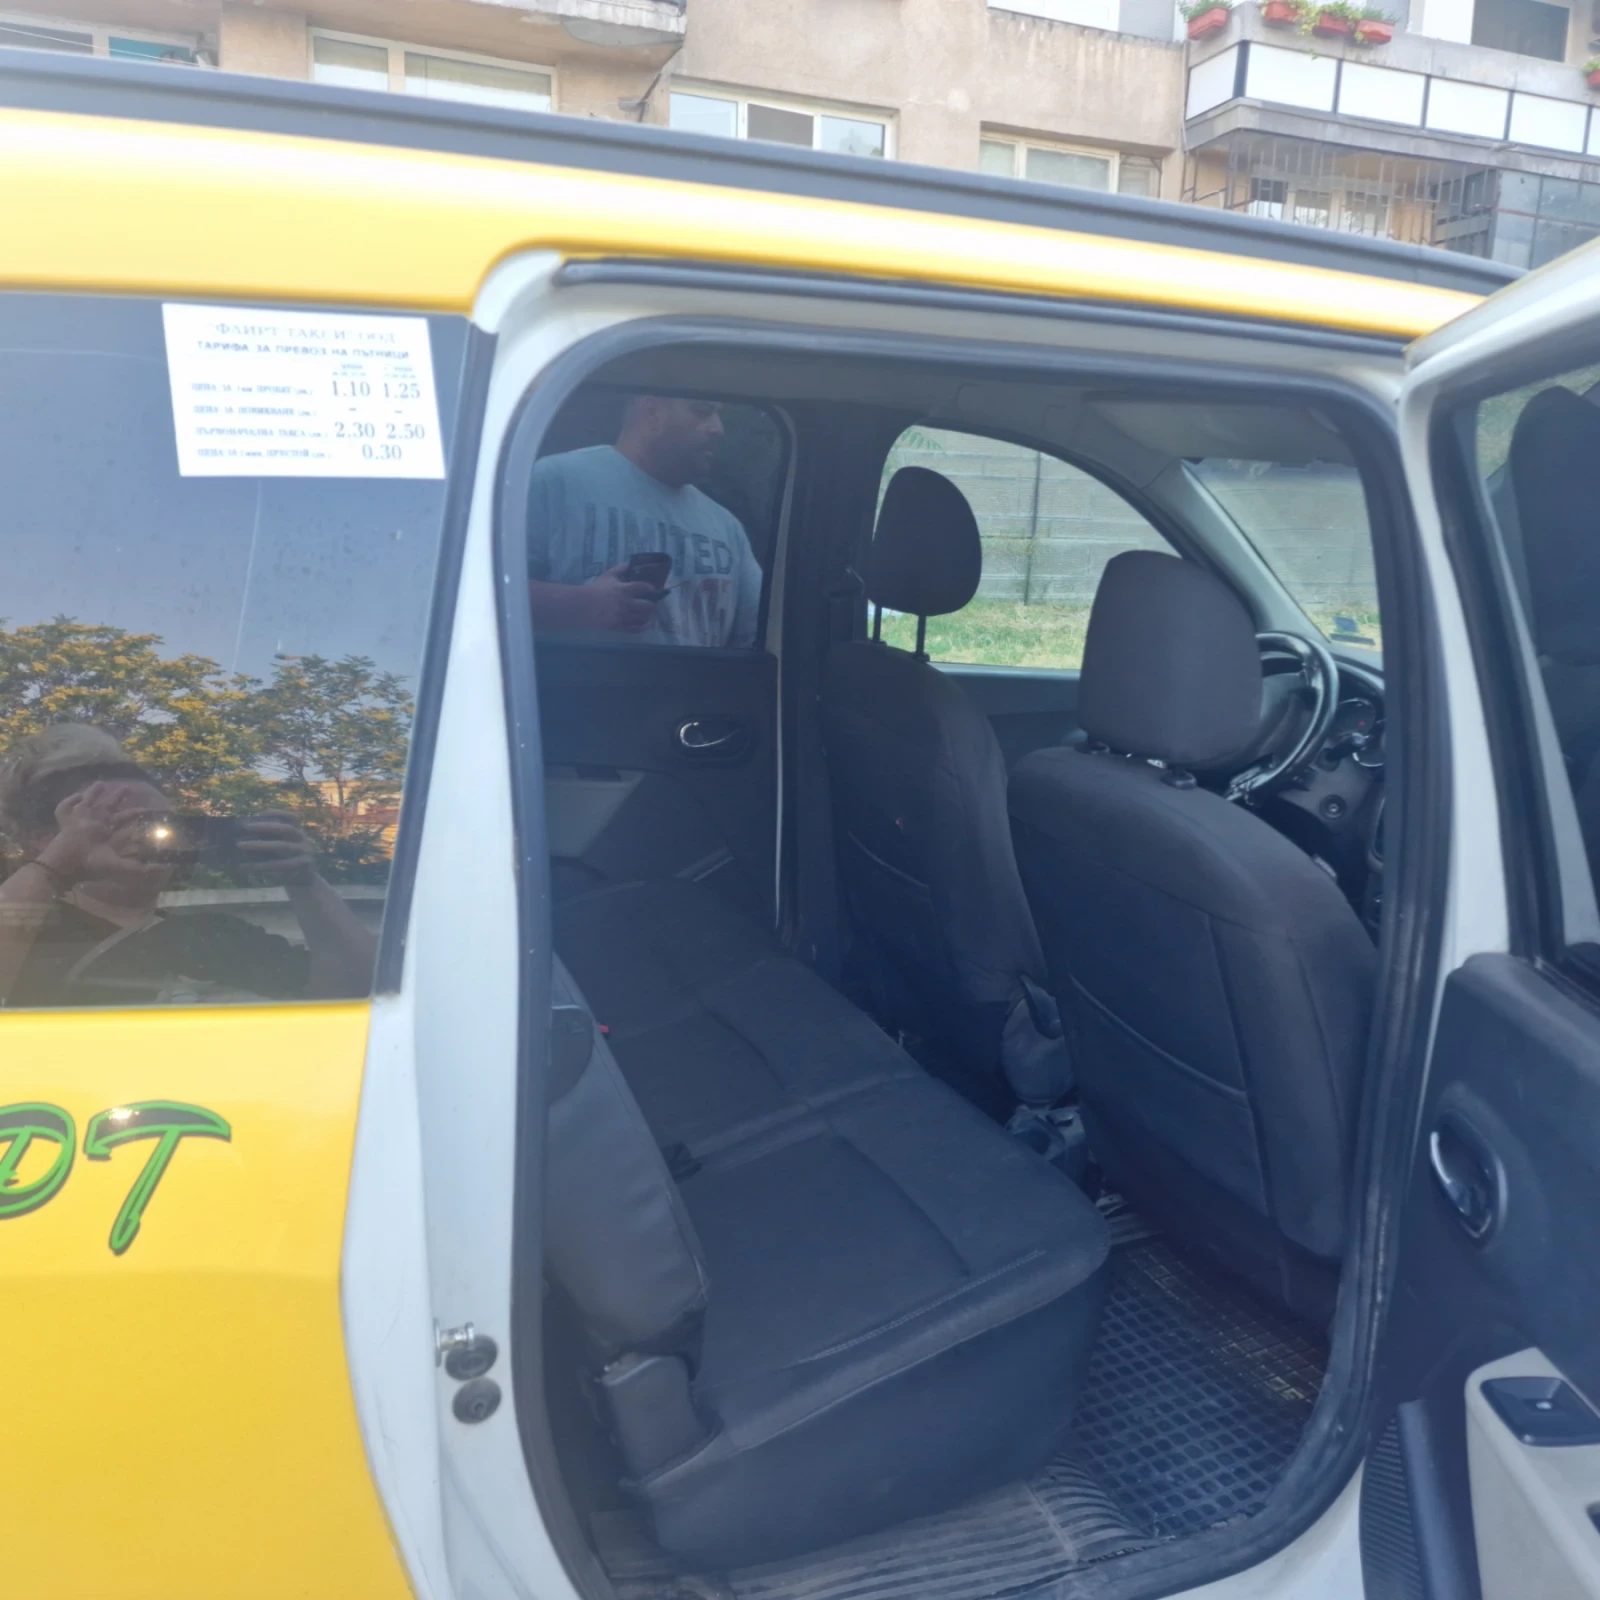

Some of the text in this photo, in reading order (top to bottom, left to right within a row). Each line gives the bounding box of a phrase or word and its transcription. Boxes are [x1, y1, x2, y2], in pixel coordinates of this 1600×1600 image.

[197, 340, 410, 360] ТАРИФА ЗА ПРЕВОЗ НА ПЪТНИЦИ
[331, 379, 372, 398] 1.10
[383, 381, 421, 400] 1.25
[333, 420, 376, 440] 2.30
[385, 422, 426, 441] 2.50
[361, 443, 403, 461] 0.30
